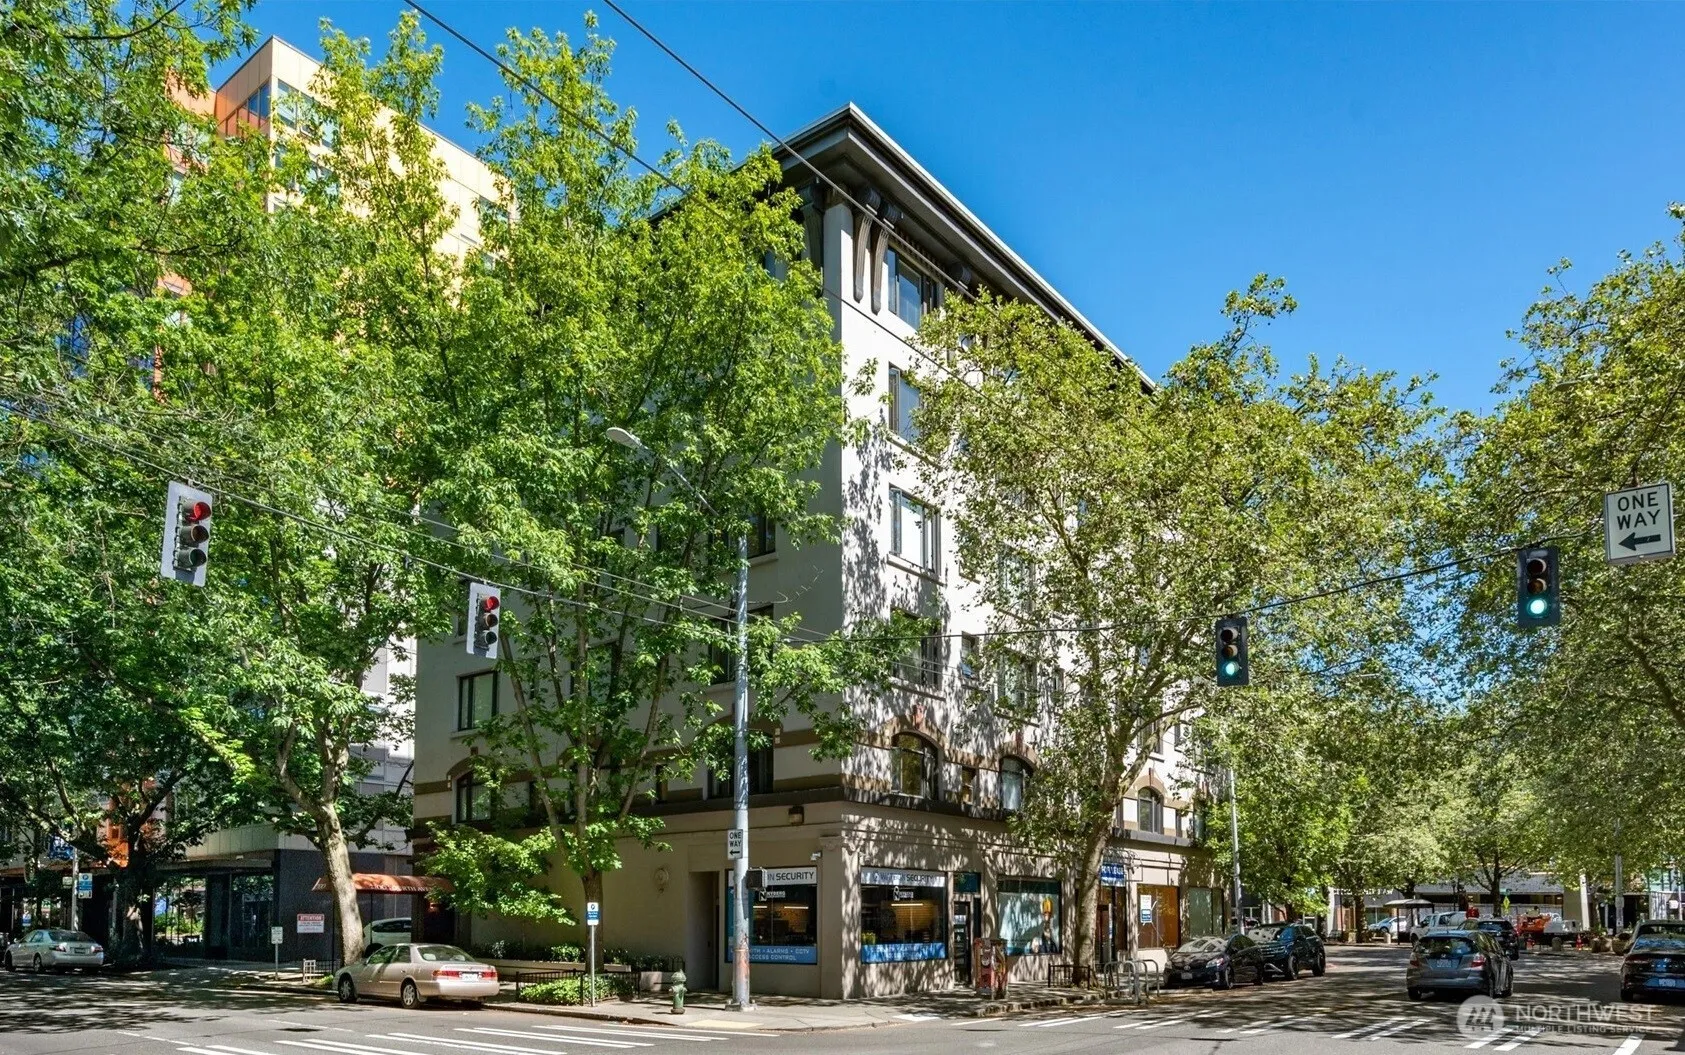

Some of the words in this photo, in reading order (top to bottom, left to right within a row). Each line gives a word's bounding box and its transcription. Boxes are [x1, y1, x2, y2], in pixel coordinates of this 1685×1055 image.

[1617, 491, 1659, 512] ONE
[1616, 509, 1660, 531] WAY
[729, 831, 742, 839] ONE
[776, 871, 815, 881] SECURITY
